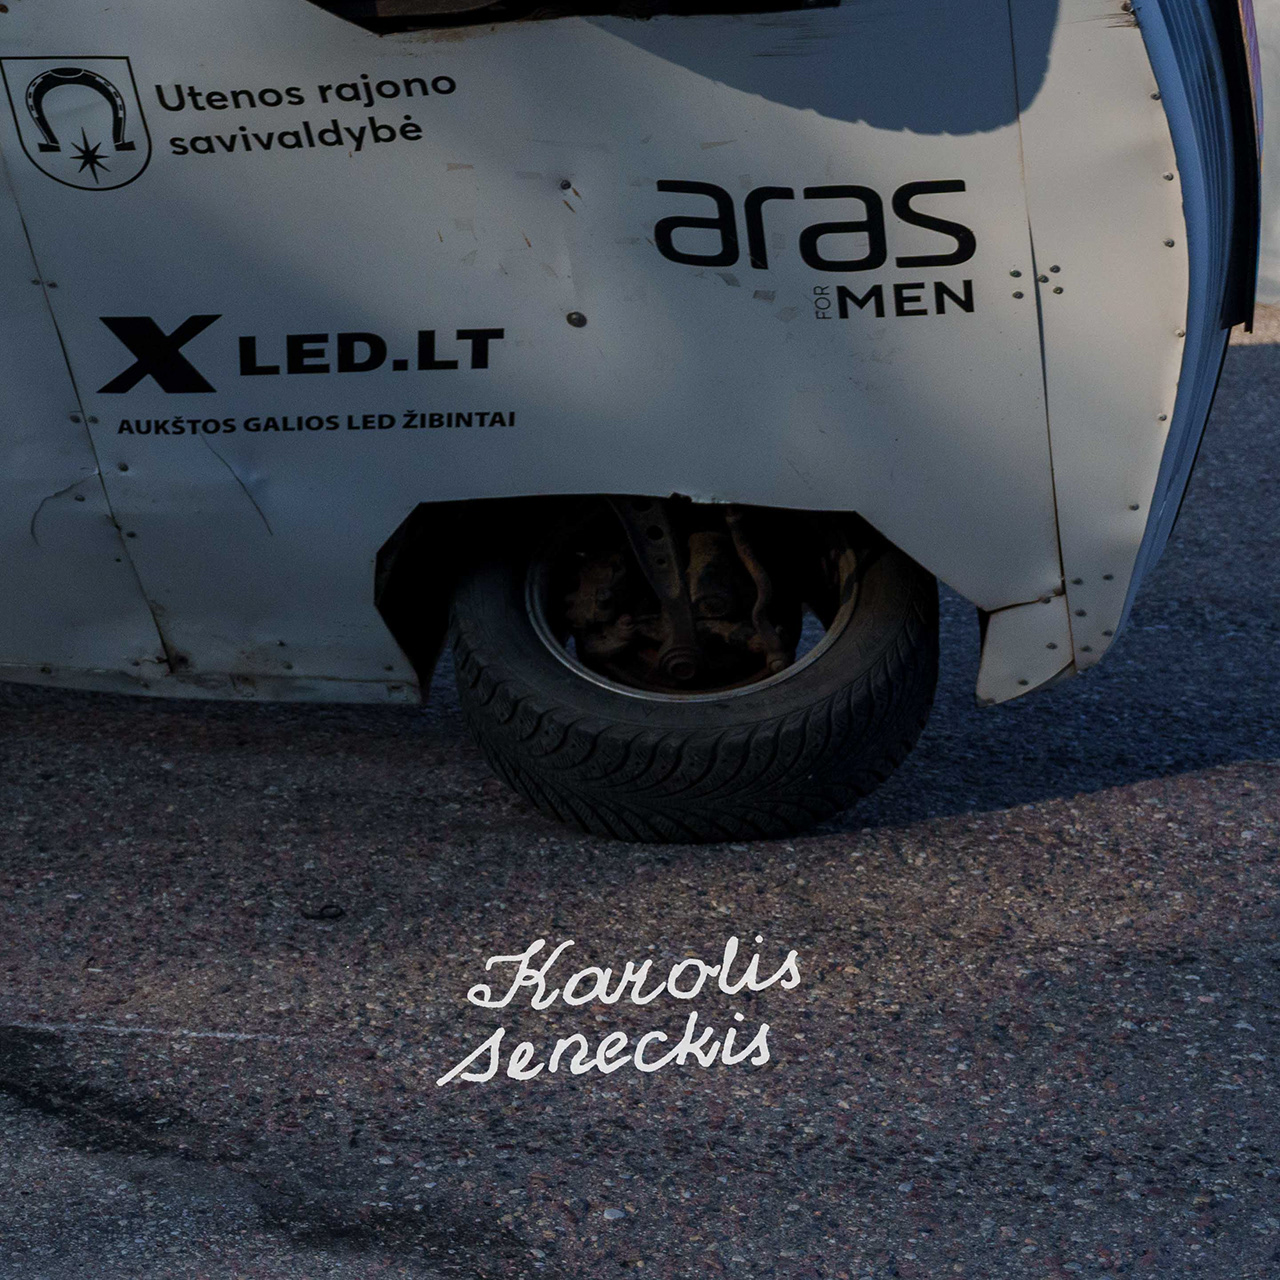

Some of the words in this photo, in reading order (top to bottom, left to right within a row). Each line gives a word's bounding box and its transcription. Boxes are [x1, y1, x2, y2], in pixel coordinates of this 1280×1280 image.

[154, 82, 306, 112] Utenos
[318, 75, 457, 109] rajono
[169, 115, 424, 156] savivaldybė
[654, 179, 977, 273] aras
[814, 284, 832, 320] FOR
[837, 279, 976, 319] MEN
[96, 314, 222, 394] X
[239, 328, 505, 377] LED.LT
[117, 412, 237, 436] AUKŠTOS
[243, 415, 340, 434] GALIOS
[347, 413, 396, 431] LED
[402, 408, 517, 429] ŽIBINTAI
